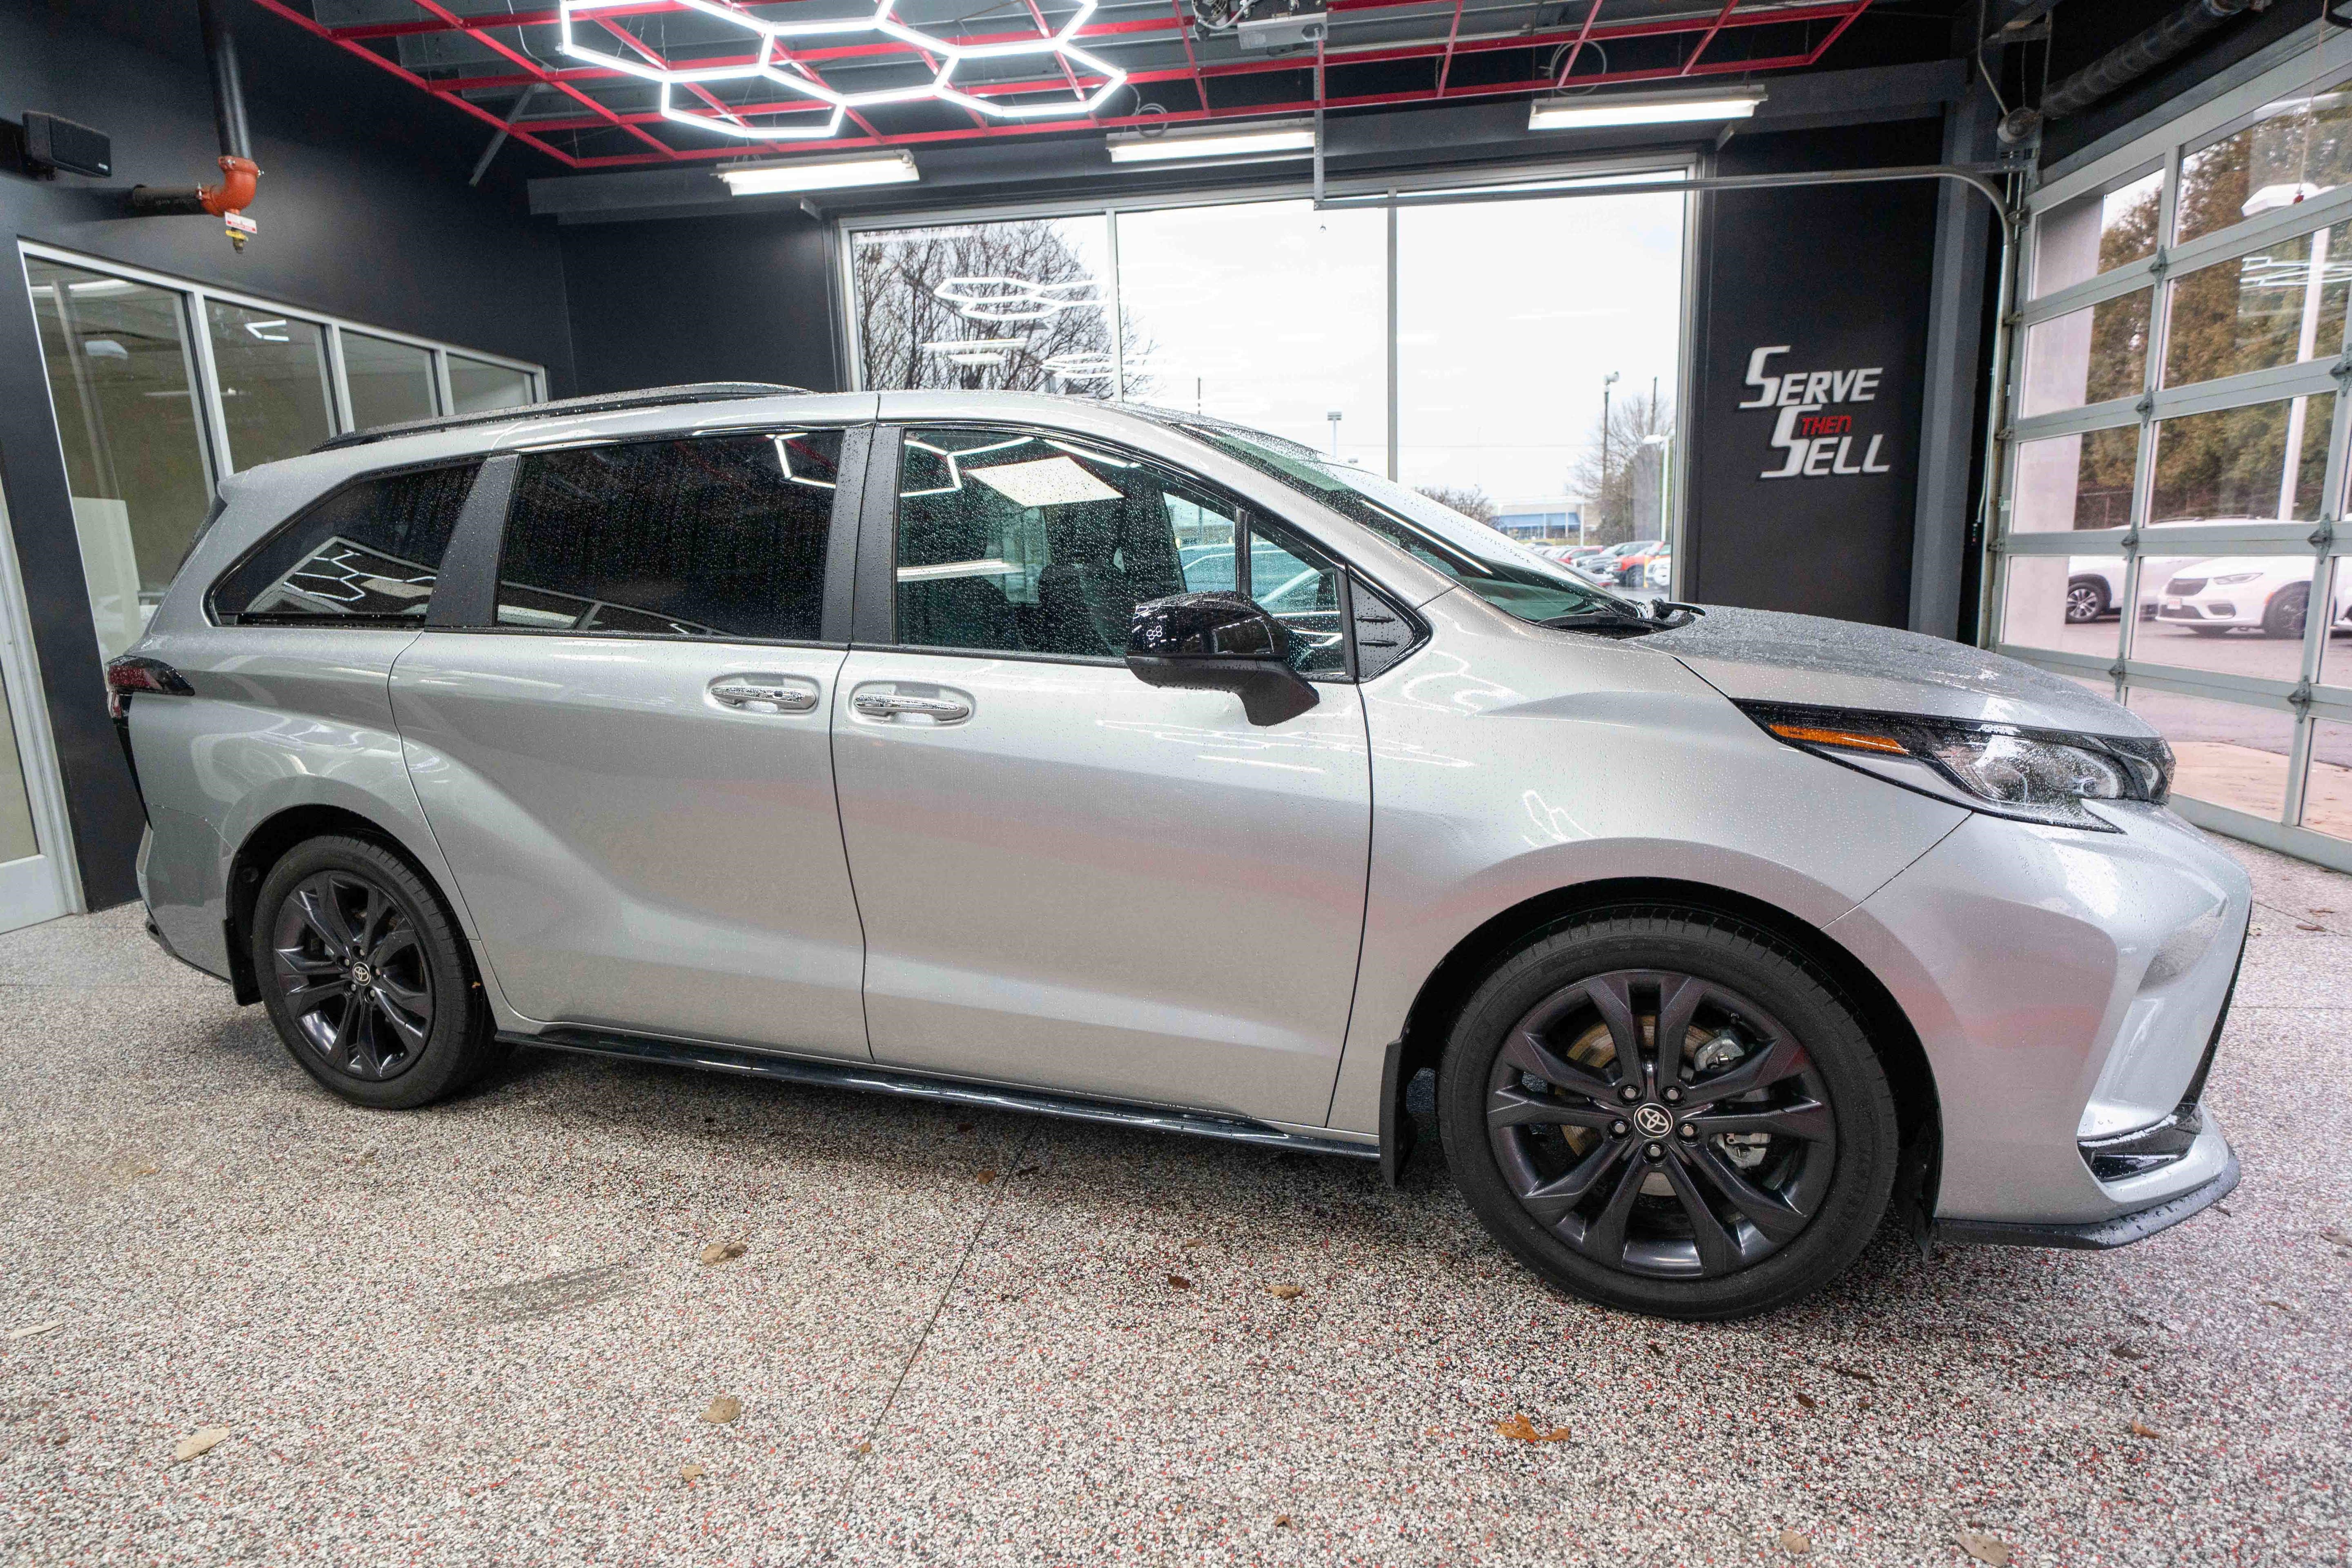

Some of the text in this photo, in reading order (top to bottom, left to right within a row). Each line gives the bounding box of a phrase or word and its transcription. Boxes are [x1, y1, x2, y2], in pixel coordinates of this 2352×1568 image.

[1739, 345, 1884, 408] SERVE
[1760, 404, 1890, 478] SELL
[1801, 415, 1852, 435] THEN
